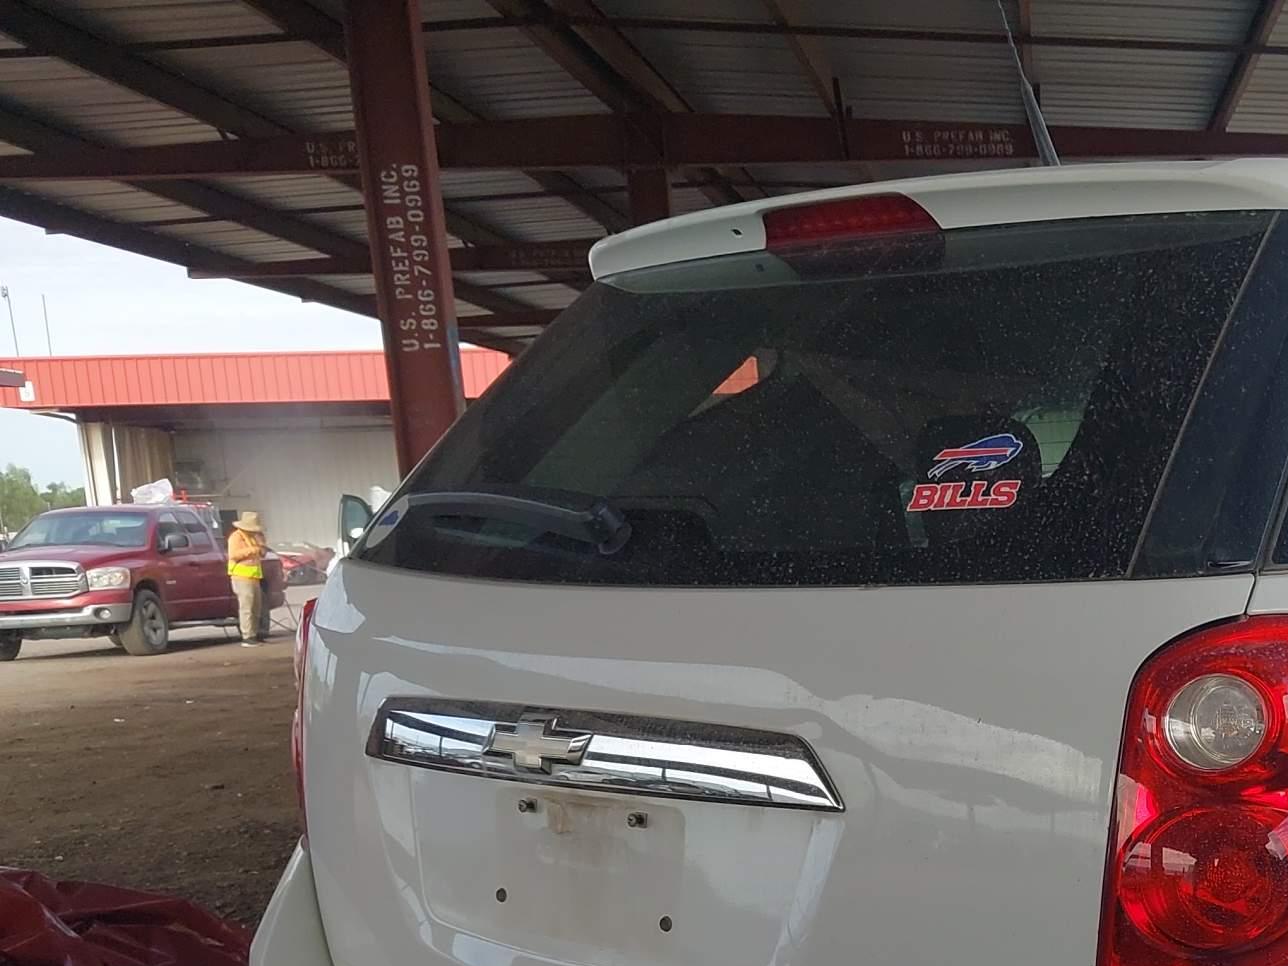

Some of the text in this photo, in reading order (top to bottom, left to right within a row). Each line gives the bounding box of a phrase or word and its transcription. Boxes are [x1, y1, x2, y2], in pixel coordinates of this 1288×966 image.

[381, 164, 420, 352] U.S. PREFAB INC.
[401, 165, 441, 349] 1-866-799-0969
[907, 480, 1021, 511] BILLS
